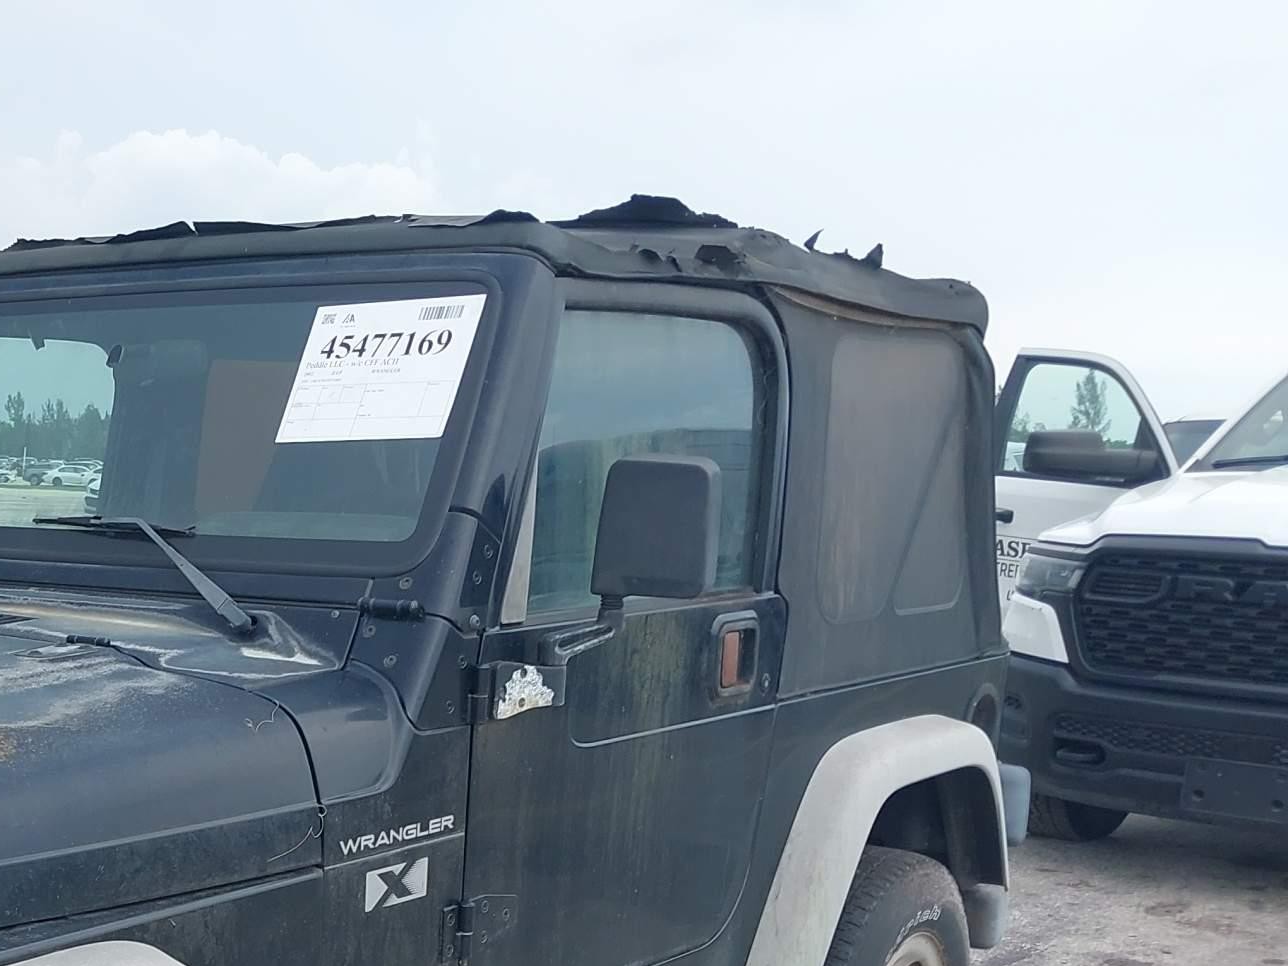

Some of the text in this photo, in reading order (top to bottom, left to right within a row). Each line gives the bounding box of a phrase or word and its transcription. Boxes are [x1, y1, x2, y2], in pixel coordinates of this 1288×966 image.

[320, 328, 453, 360] 45477169
[339, 814, 455, 856] WRANGLER
[365, 857, 429, 913] X
